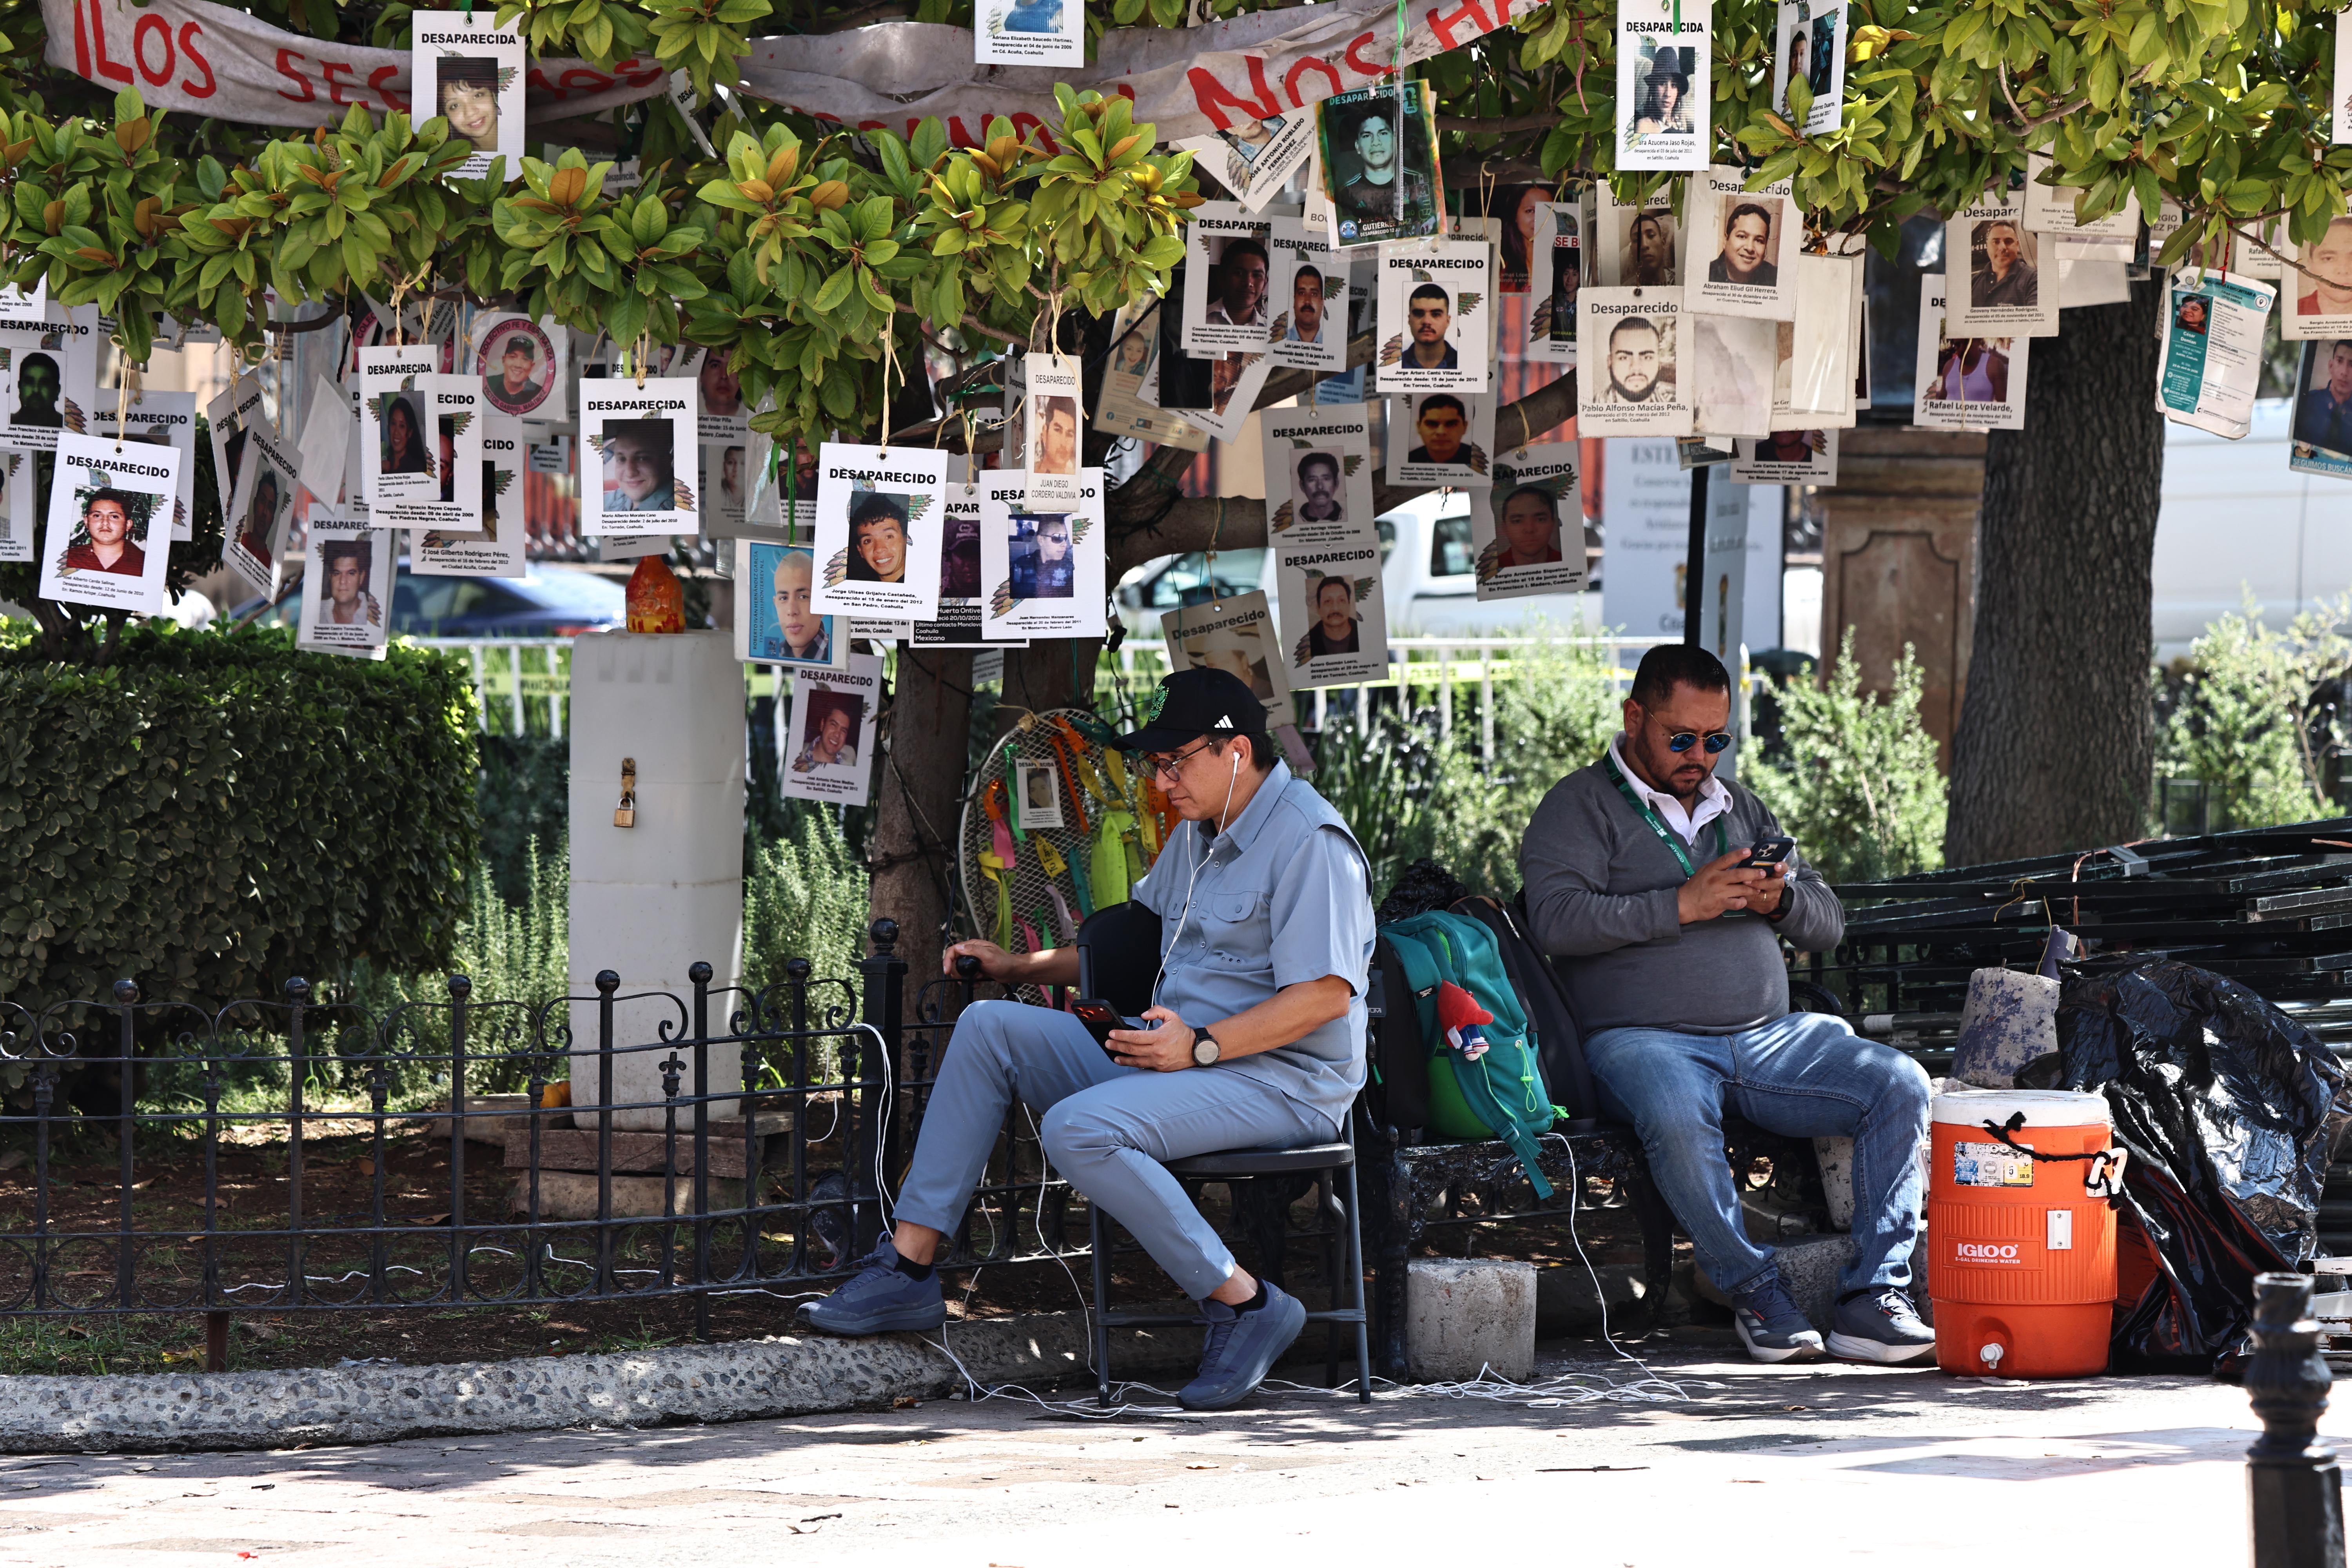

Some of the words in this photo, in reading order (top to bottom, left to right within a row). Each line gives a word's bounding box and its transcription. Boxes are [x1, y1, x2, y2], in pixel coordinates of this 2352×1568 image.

[1626, 22, 1704, 33] DESAPARCIDA
[422, 34, 516, 44] DESAPARECIDA
[1249, 166, 1261, 181] JOSÉ
[1261, 143, 1282, 167] ANTONIO
[1281, 118, 1304, 143] ROBLEDO
[1267, 139, 1296, 170] FERNÁNDEZ
[1710, 180, 1790, 195] Desapecido
[1199, 219, 1271, 231] DESAPAREC
[1274, 239, 1328, 252] DESAPARECI
[1555, 236, 1568, 247] SE
[1390, 259, 1483, 270] DESAPARECIDO
[1592, 301, 1677, 316] Desaparecido
[0, 320, 88, 335] ESAPARECIDO
[482, 322, 510, 356] COLECTIVO
[528, 324, 554, 361] ESPERANZA
[368, 363, 432, 375] DESAPARECIDA
[1036, 375, 1074, 385] DESAPARECIDO
[499, 402, 522, 411] GABRIEL
[588, 400, 686, 411] DESAPARECIDA
[94, 411, 187, 426] DESPARECIDO
[1273, 425, 1363, 438] DESAPARECIDO
[252, 432, 296, 479] DESAPARECIDO
[67, 455, 169, 478] DESAPARECIDO
[2293, 458, 2326, 470] SEGUIMOS
[830, 467, 936, 484] DESAPARECIDO
[1491, 463, 1572, 480] SAPARECIDO
[991, 488, 1095, 502] DESADO
[1031, 490, 1054, 498] CORDERO
[314, 521, 370, 530] DESAPAREC
[1285, 549, 1374, 566] DESAPARECIDO
[1172, 610, 1265, 641] Desaparecido
[800, 670, 872, 686] DESAPARECIDO
[1958, 1243, 2017, 1258] IGLOO
